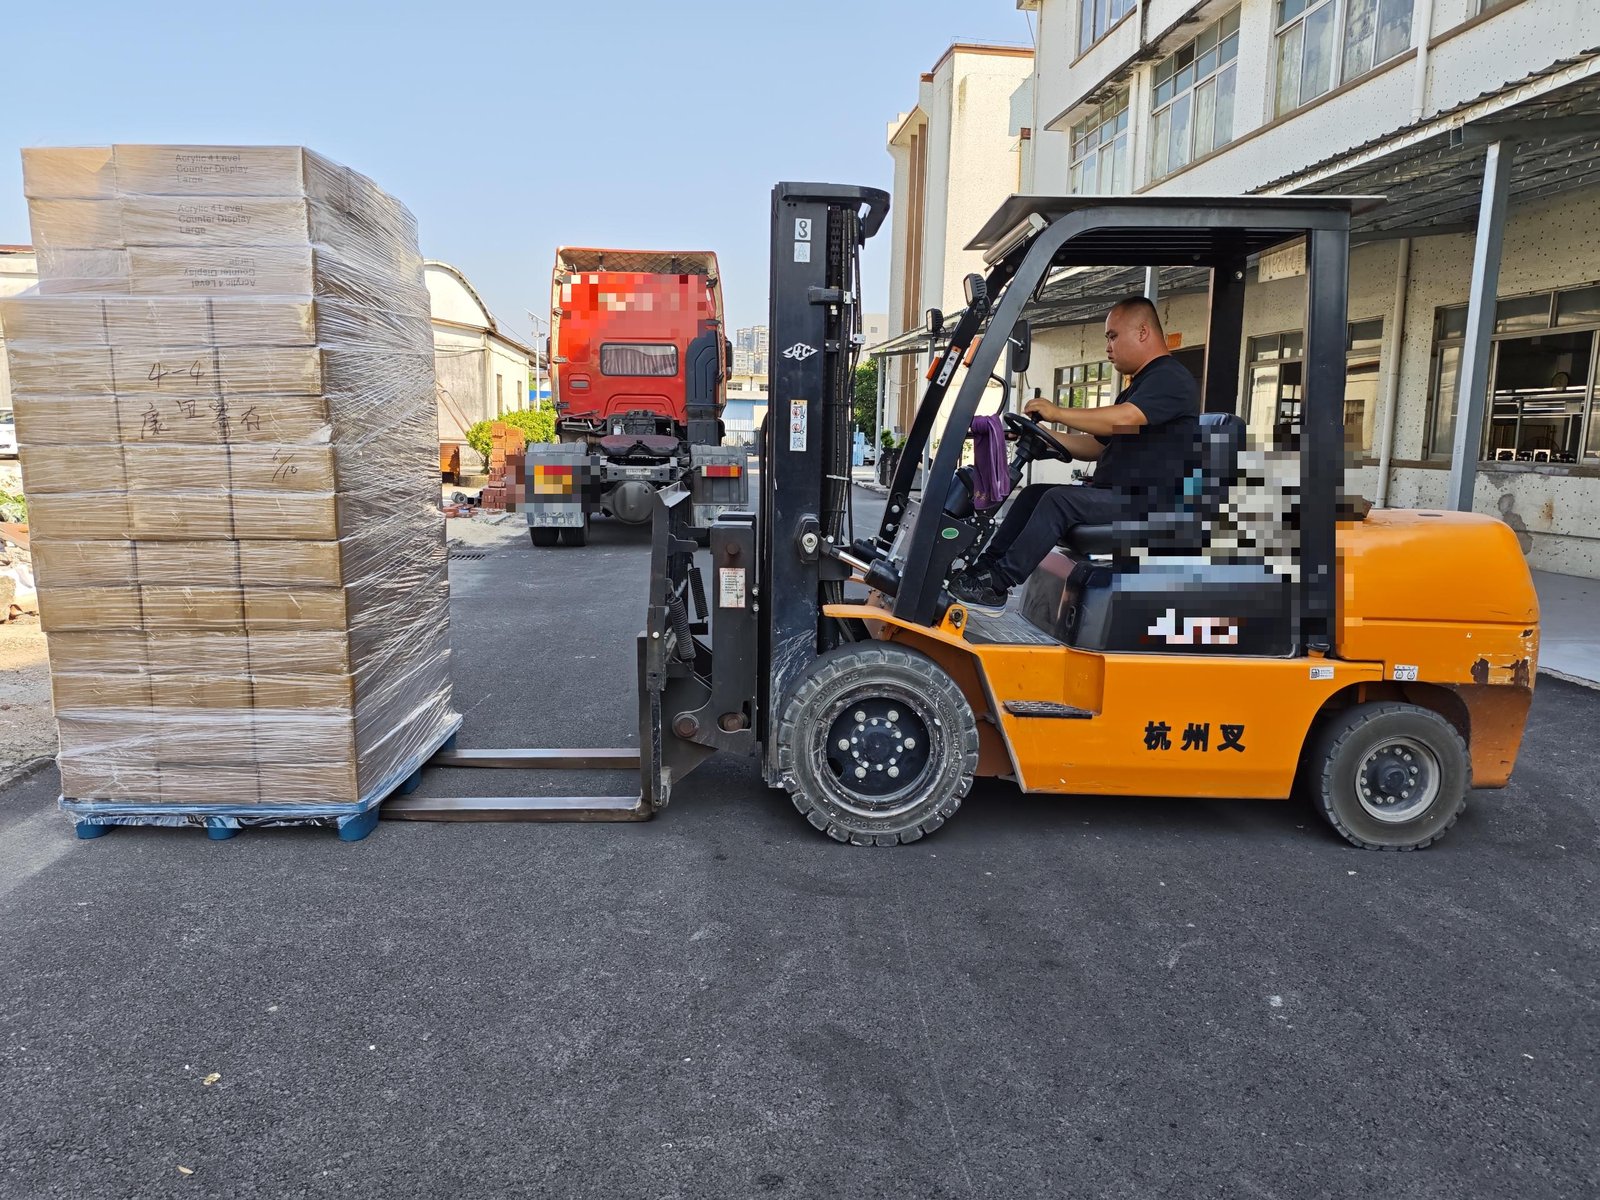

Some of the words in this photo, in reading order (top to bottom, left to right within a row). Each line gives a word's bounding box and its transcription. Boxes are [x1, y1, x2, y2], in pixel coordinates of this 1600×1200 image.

[175, 153, 206, 163] Acrylic
[215, 153, 241, 162] Level
[176, 163, 213, 173] Counter
[214, 164, 249, 174] Display
[178, 204, 209, 214] Acrylic
[211, 204, 216, 212] 4
[218, 204, 243, 213] Level
[178, 214, 215, 223] Counter
[217, 214, 252, 224] Display
[179, 226, 206, 235] Large
[183, 268, 218, 277] Display
[220, 268, 256, 277] Counter
[191, 279, 216, 288] Level
[225, 277, 256, 287] Acrylic
[148, 360, 205, 388] 4-4
[1143, 721, 1246, 752] 杭州叉
